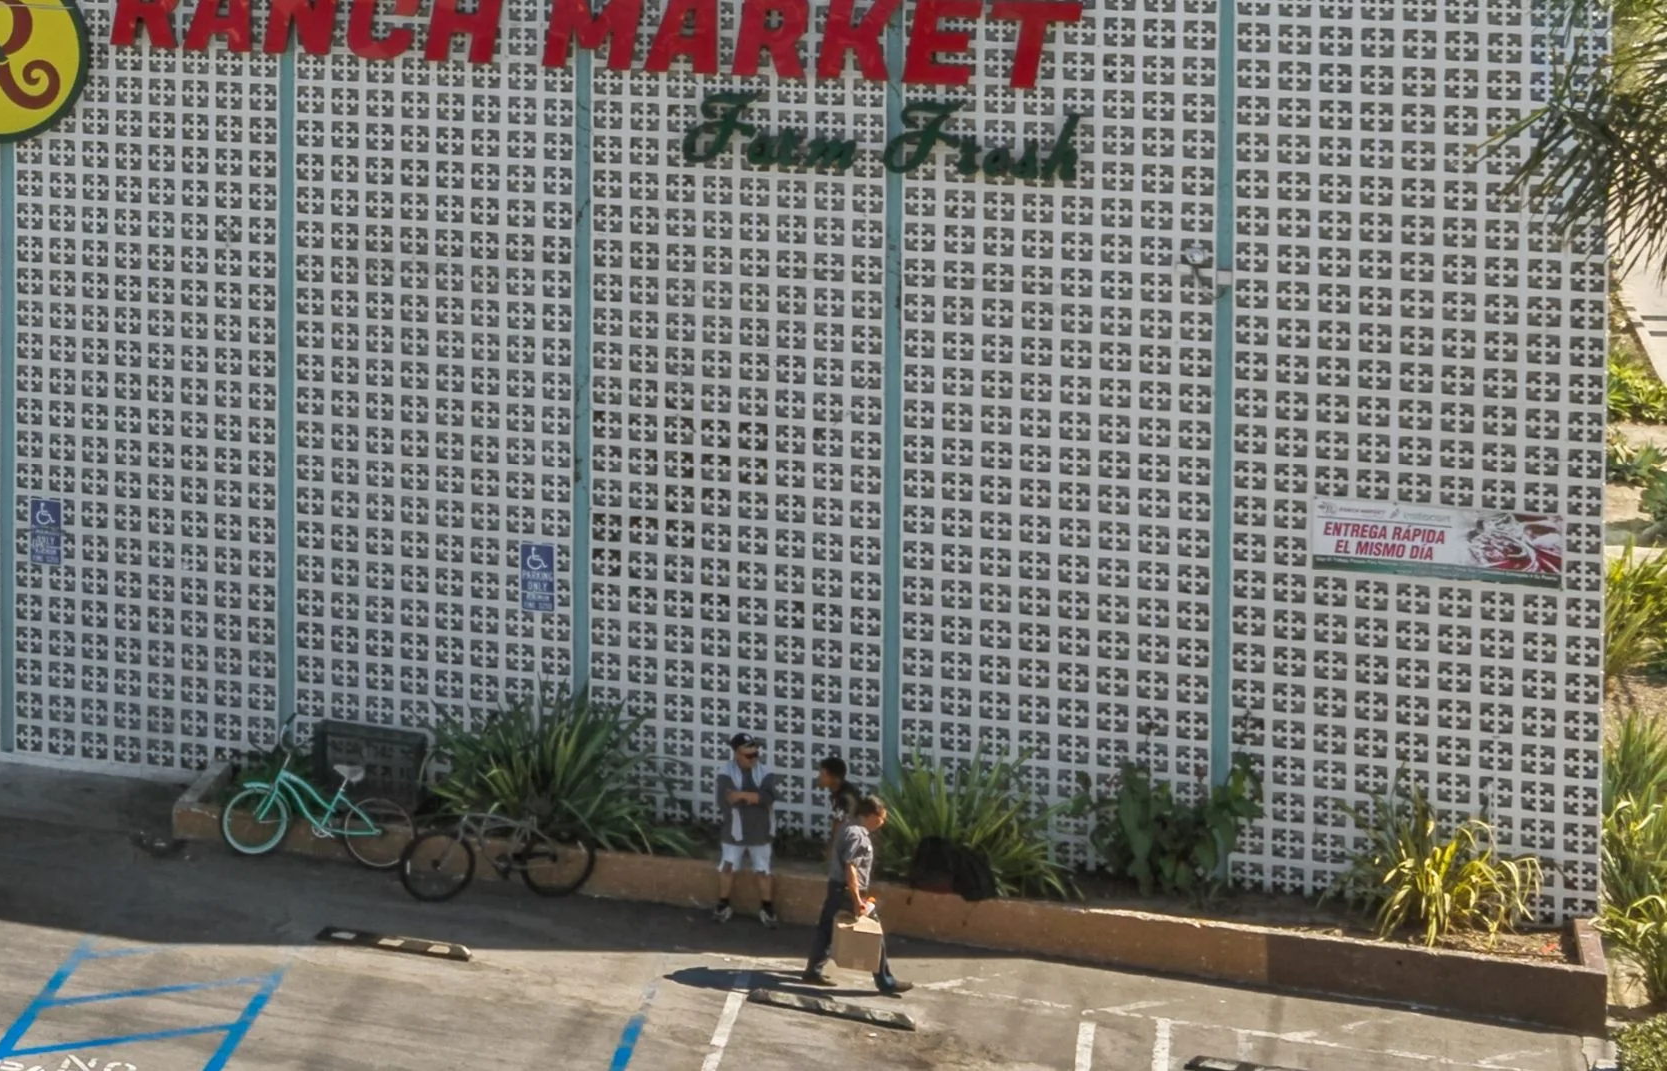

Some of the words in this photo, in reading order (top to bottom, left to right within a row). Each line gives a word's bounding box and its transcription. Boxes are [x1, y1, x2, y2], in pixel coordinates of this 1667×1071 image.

[683, 90, 857, 171] Farm
[884, 99, 1083, 181] Fresh
[1323, 521, 1388, 539] ENTREGA
[1392, 524, 1446, 544] RÁPIDA
[1335, 539, 1351, 554] EL
[1355, 541, 1405, 559] MISMO
[1409, 542, 1434, 561] DÍA
